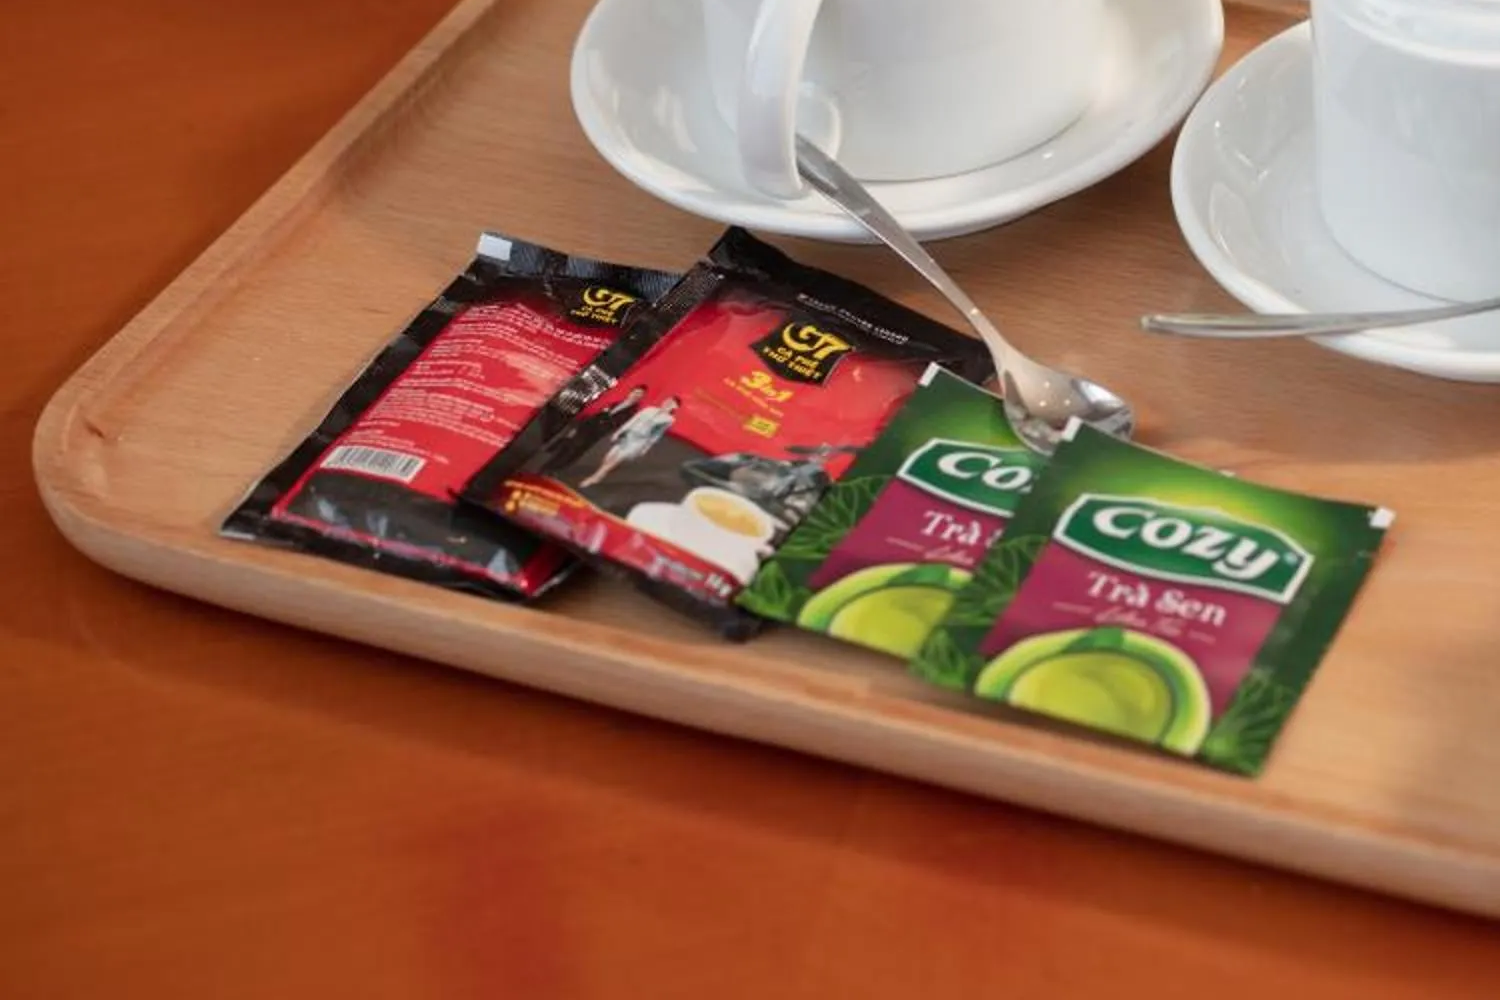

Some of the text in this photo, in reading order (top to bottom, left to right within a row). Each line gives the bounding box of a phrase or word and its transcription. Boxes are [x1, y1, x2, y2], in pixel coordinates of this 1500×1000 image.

[937, 451, 1033, 493] Co
[920, 509, 982, 547] Trà
[1087, 570, 1151, 608] Trà
[1154, 587, 1228, 627] Sen
